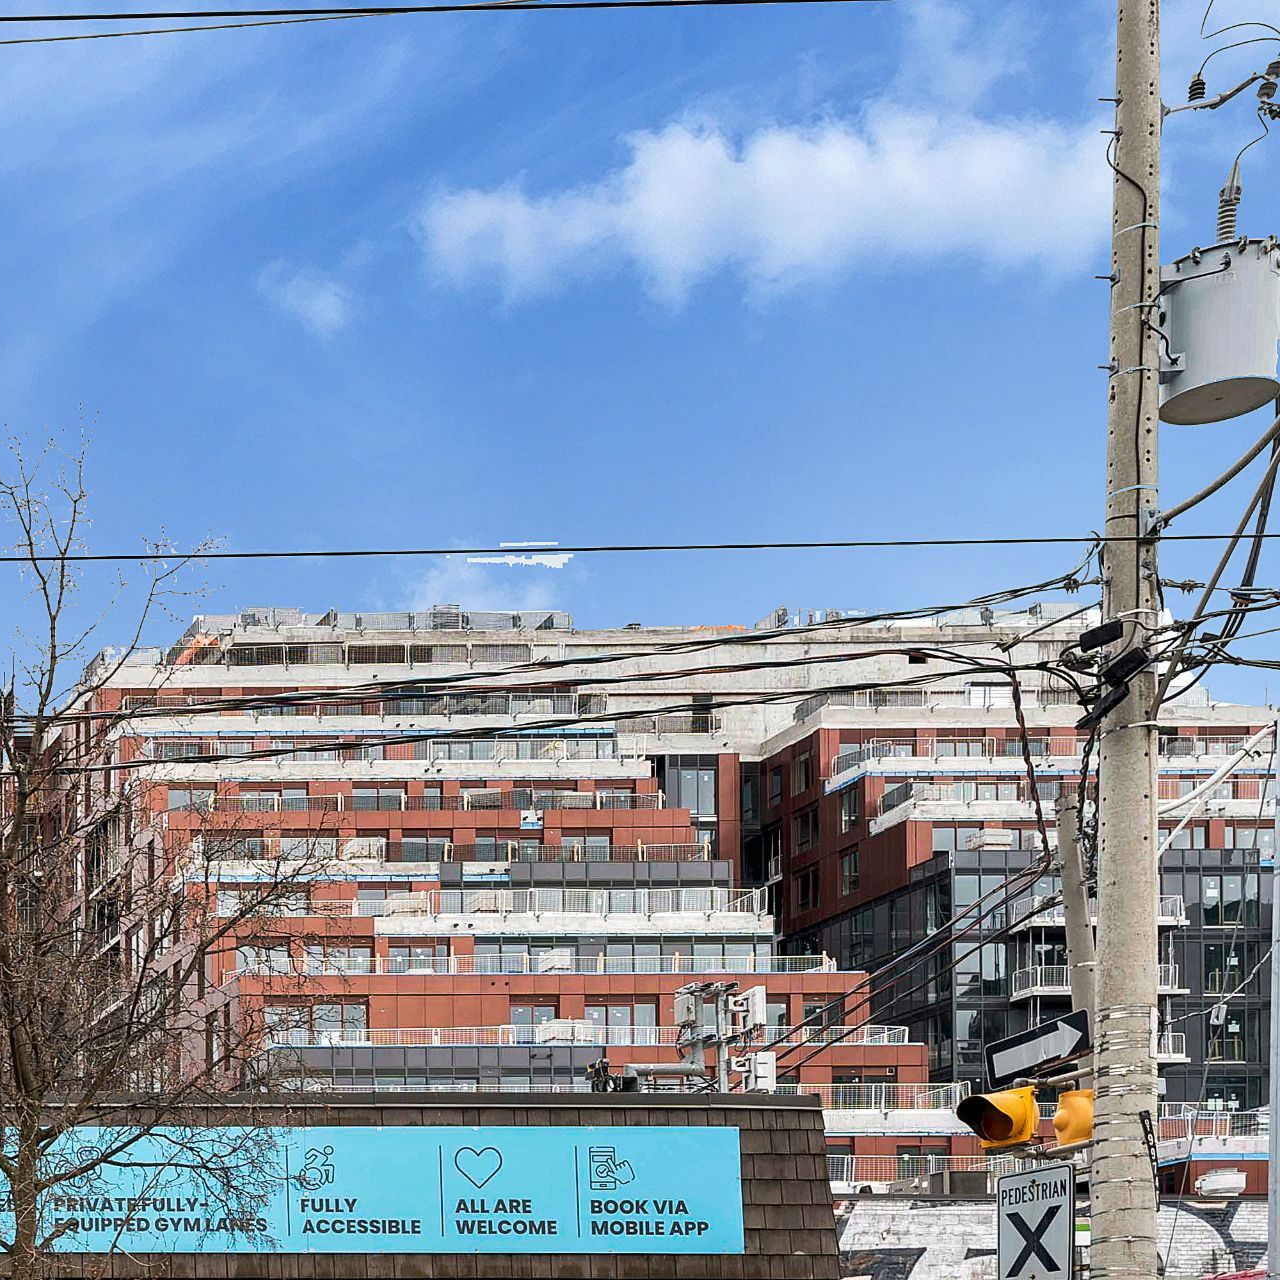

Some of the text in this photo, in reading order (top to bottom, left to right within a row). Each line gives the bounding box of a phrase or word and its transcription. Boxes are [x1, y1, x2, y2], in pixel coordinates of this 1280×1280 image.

[1001, 1178, 1067, 1208] PEDESTRIAN
[300, 1198, 358, 1214] FULLY
[455, 1199, 532, 1215] ALL ARE
[590, 1199, 689, 1216] BOOK VIA
[154, 1217, 200, 1232] GYM
[207, 1217, 268, 1232] LANES
[302, 1219, 422, 1235] ACCESSIBLE
[455, 1219, 558, 1236] WELCOME
[591, 1220, 710, 1236] MOBILE APP
[1005, 1204, 1063, 1279] X
